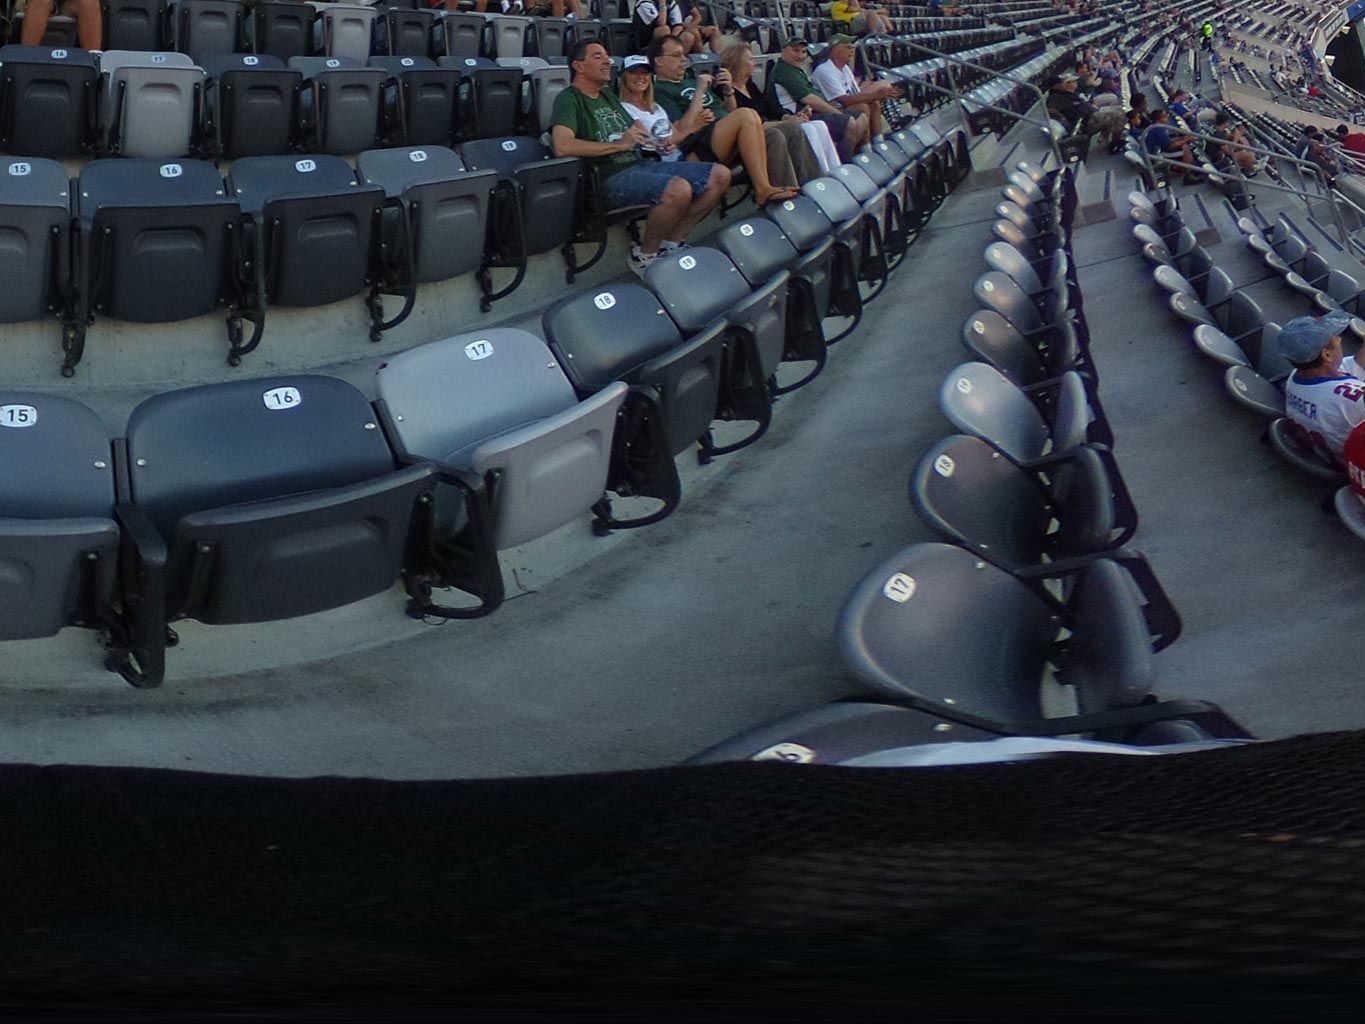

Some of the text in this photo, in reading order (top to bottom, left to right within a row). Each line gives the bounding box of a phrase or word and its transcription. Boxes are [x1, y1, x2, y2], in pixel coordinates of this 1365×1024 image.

[13, 164, 28, 174] 15
[164, 165, 179, 176] 16
[298, 161, 313, 171] 17
[598, 295, 612, 307] 18
[470, 343, 489, 358] 17
[271, 390, 294, 406] 16
[1334, 382, 1364, 402] 2
[6, 408, 30, 424] 15
[889, 577, 910, 595] 17
